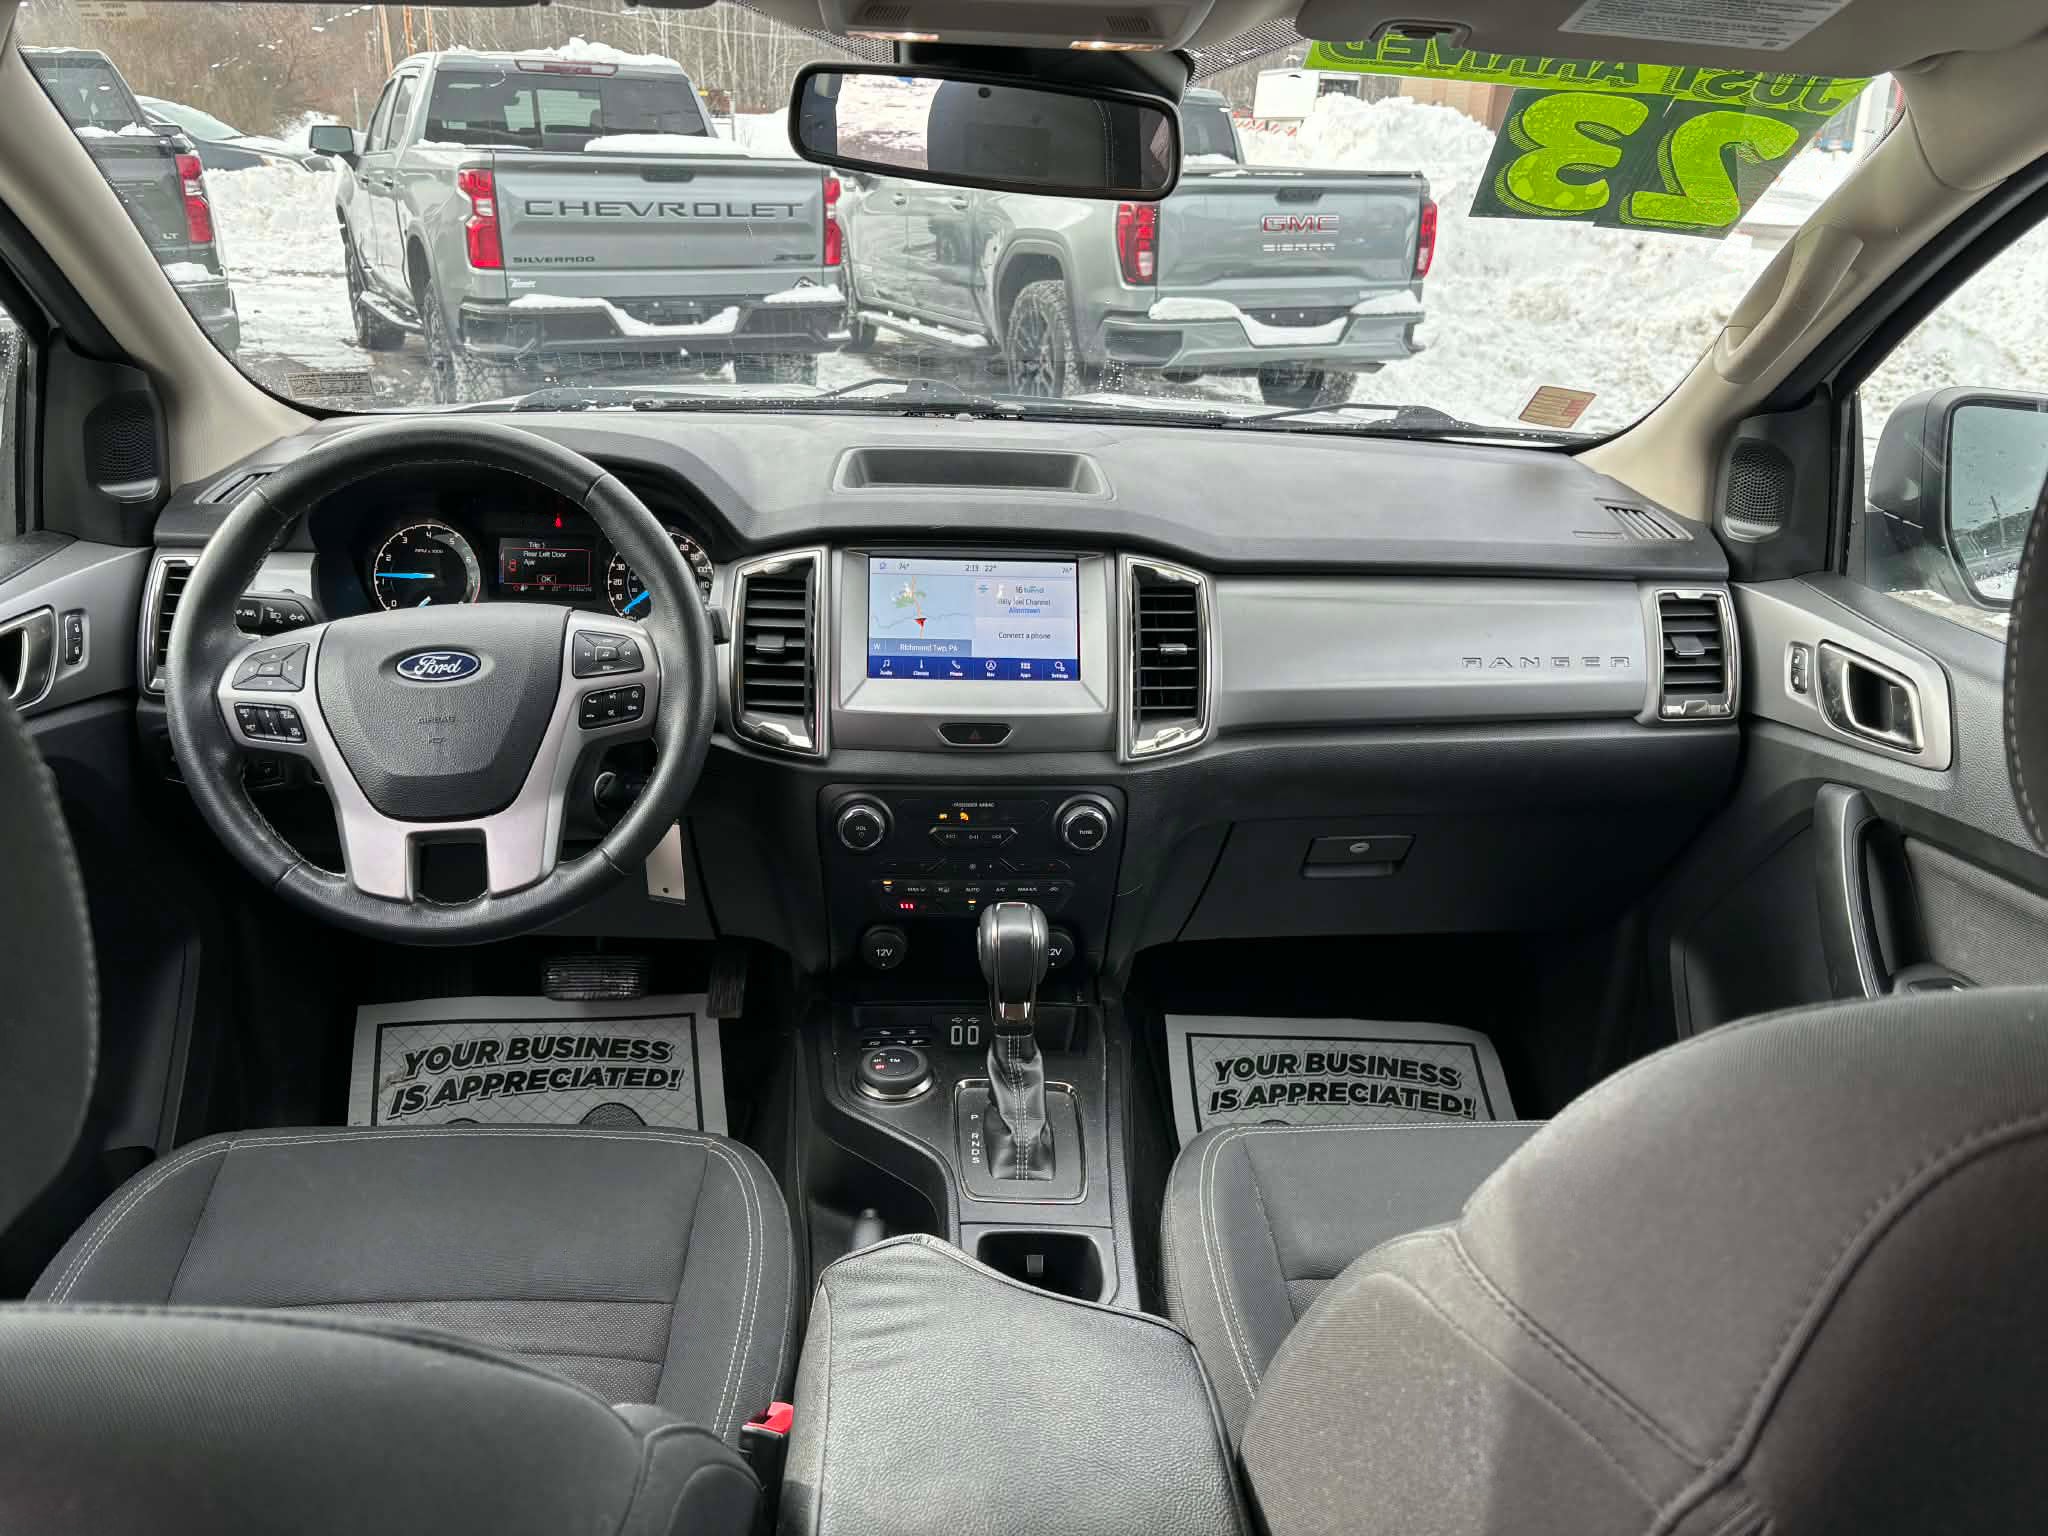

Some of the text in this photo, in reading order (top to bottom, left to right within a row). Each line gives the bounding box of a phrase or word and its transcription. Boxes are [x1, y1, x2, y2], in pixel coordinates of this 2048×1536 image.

[524, 200, 804, 218] CHEVROLET
[1261, 215, 1340, 233] GMC
[1262, 243, 1336, 252] SIERRA
[512, 256, 596, 264] SILVERADO
[402, 536, 408, 544] 3
[426, 531, 432, 540] 4
[998, 631, 1025, 640] Connect
[1030, 632, 1051, 641] phone
[873, 642, 881, 651] W
[414, 655, 462, 676] Ford
[1462, 657, 1632, 668] RANGER
[875, 948, 893, 957] 12V
[402, 1036, 674, 1079] YOUR BUSINESS
[1214, 1052, 1463, 1088] YOUR BUSINESS
[388, 1068, 685, 1118] IS APPRECIATED!
[1209, 1082, 1477, 1119] IS APPRECIATED!
